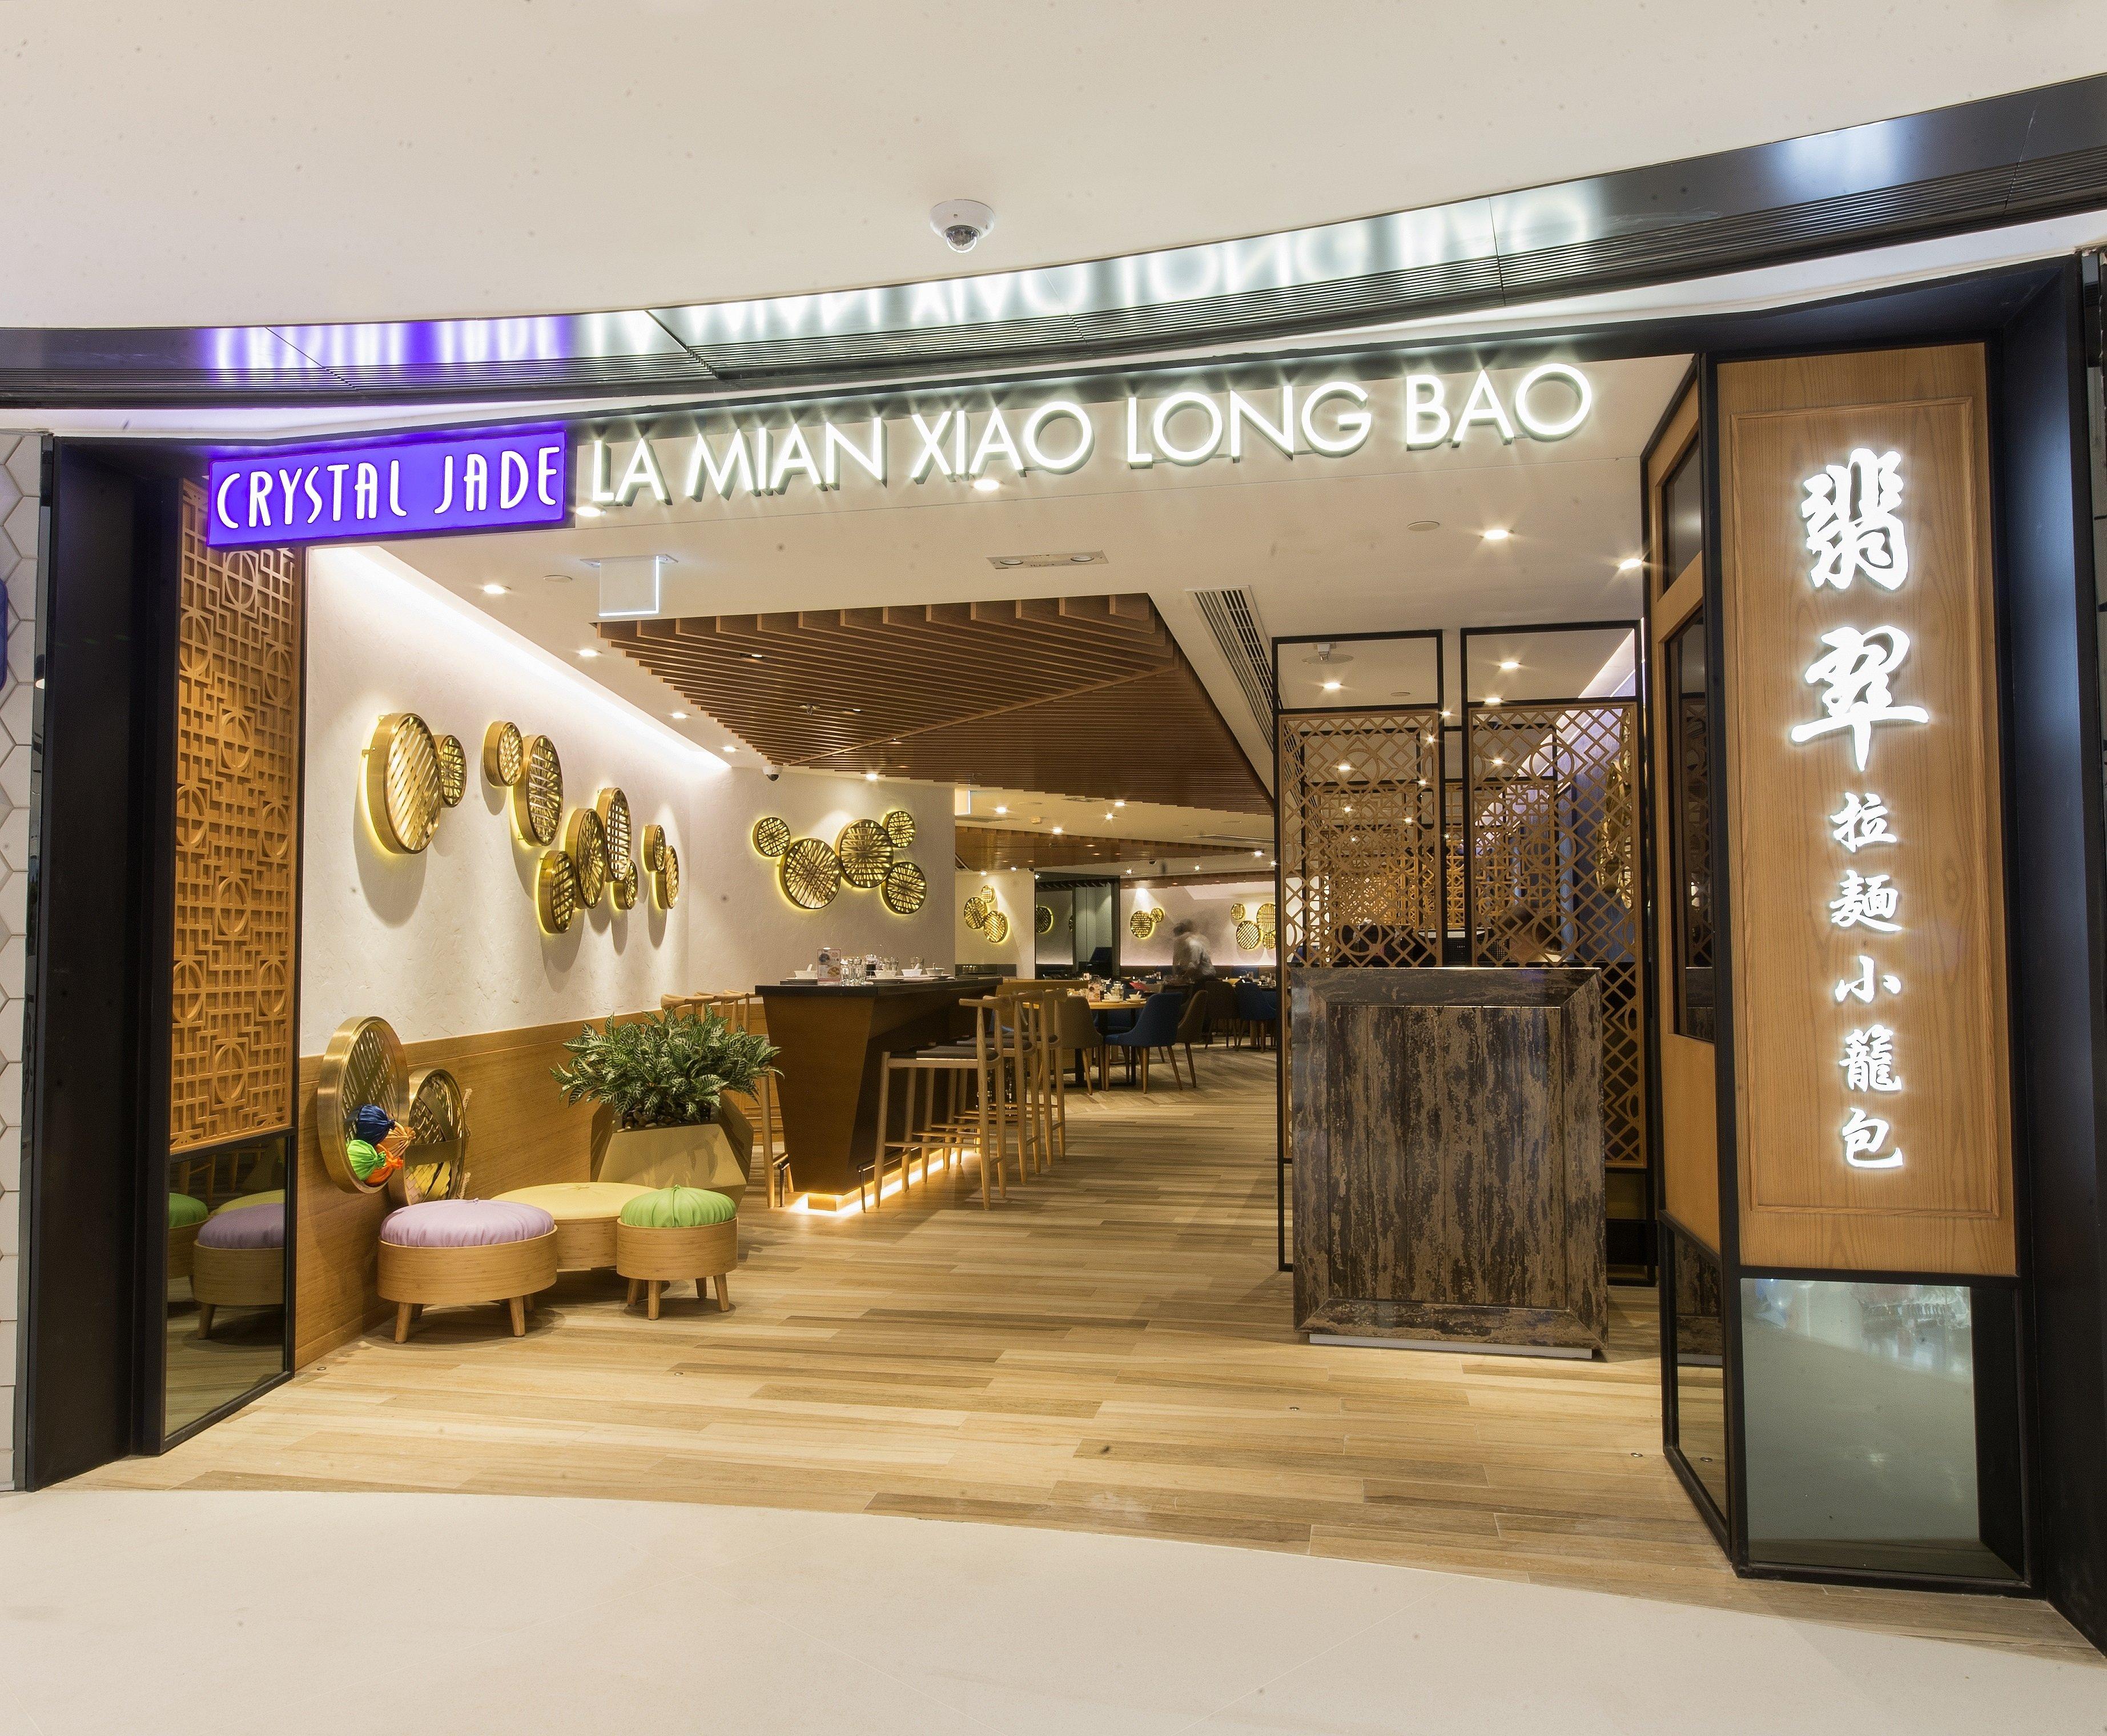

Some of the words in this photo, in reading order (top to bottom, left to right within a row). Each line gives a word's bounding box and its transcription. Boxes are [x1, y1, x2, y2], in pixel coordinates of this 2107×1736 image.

[216, 459, 408, 529] CRYSTAL
[433, 446, 560, 515] JADE
[592, 438, 665, 501] LA
[685, 417, 882, 496] MIAN
[910, 401, 1092, 479] XIAO
[1127, 381, 1372, 462] LONG
[1406, 363, 1592, 444] BAO
[1791, 448, 1929, 771] 翡翠
